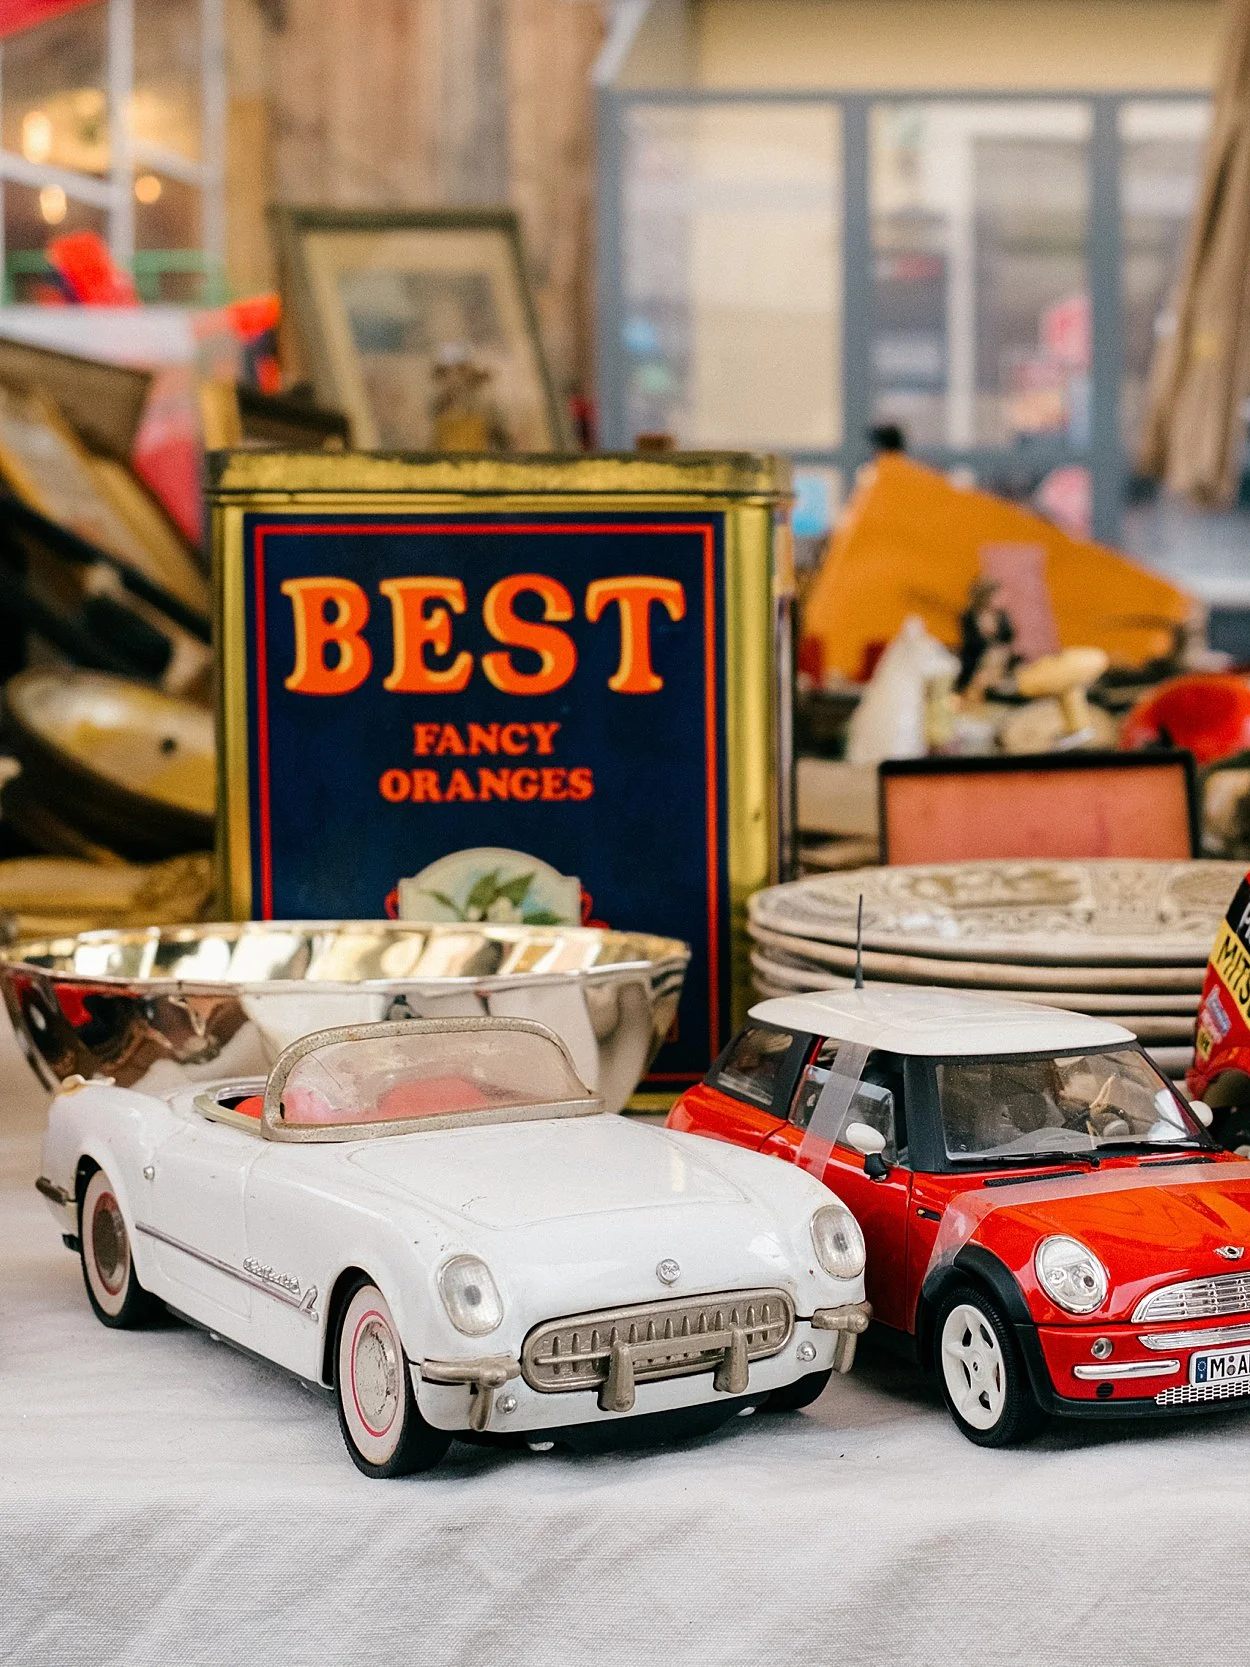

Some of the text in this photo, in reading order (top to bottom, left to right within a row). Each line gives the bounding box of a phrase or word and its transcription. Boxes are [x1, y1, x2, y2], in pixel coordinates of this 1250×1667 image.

[280, 572, 686, 696] BEST
[413, 722, 561, 757] FANCY
[378, 766, 594, 803] ORANGES
[1210, 1357, 1225, 1379] M
